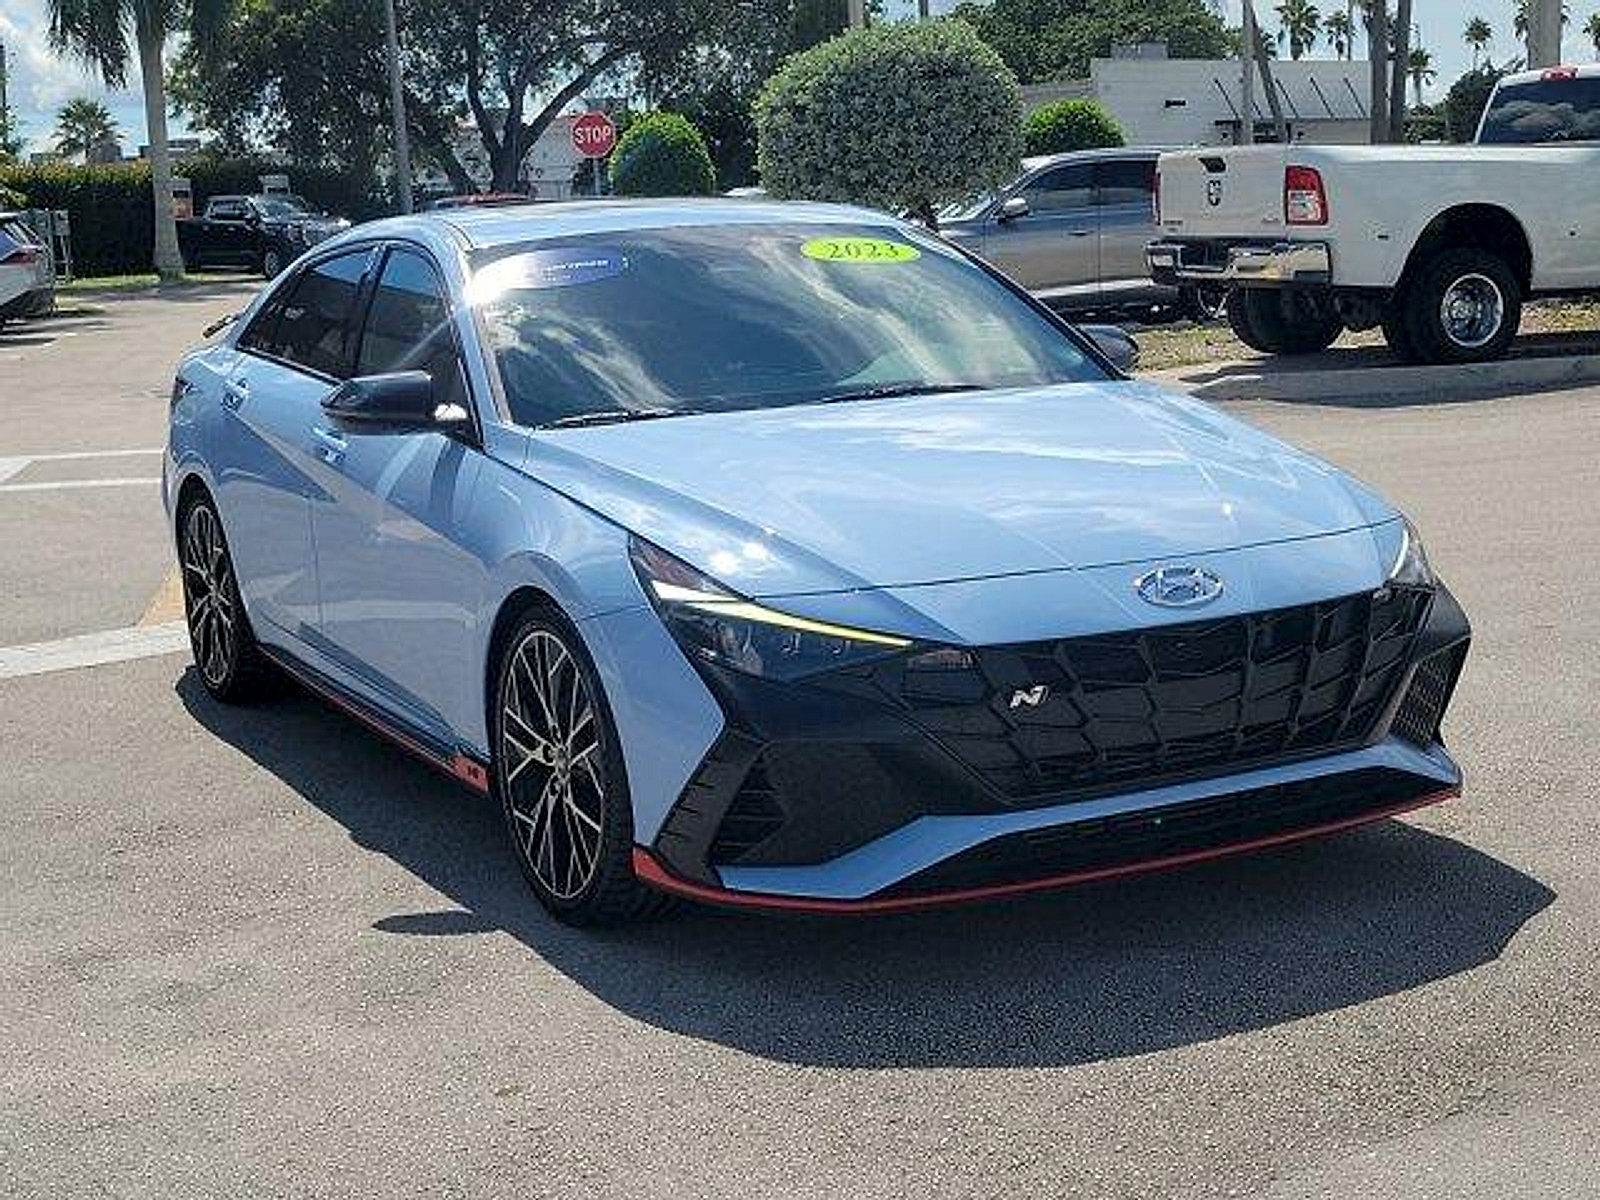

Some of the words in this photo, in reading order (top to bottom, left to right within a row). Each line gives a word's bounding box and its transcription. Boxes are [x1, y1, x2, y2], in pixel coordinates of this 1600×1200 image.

[574, 125, 612, 144] STOP
[826, 242, 900, 259] 2023
[1009, 685, 1049, 709] N
